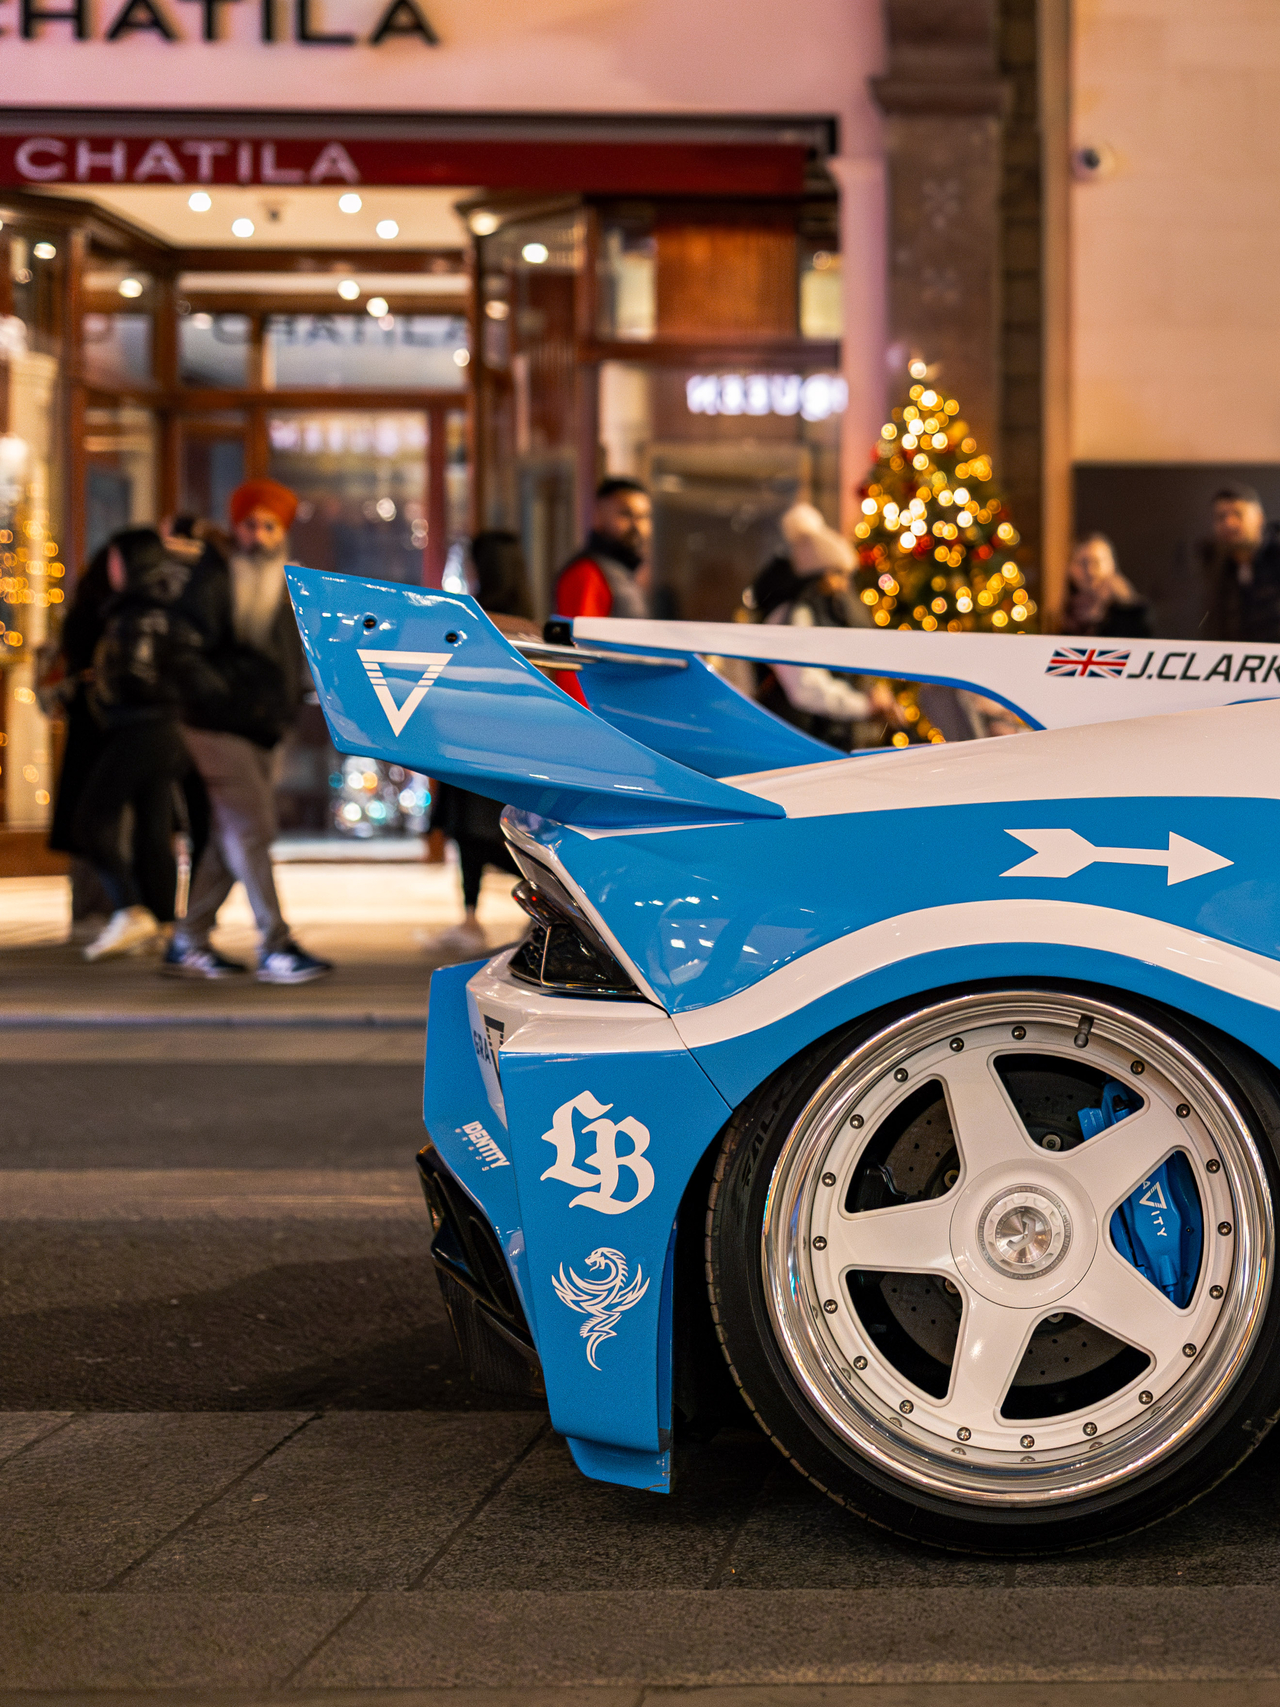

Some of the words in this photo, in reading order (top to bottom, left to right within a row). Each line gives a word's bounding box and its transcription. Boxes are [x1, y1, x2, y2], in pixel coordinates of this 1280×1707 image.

[0, 0, 441, 46] HATILA
[14, 138, 362, 184] CHATILA
[462, 1121, 511, 1168] IDENTITY
